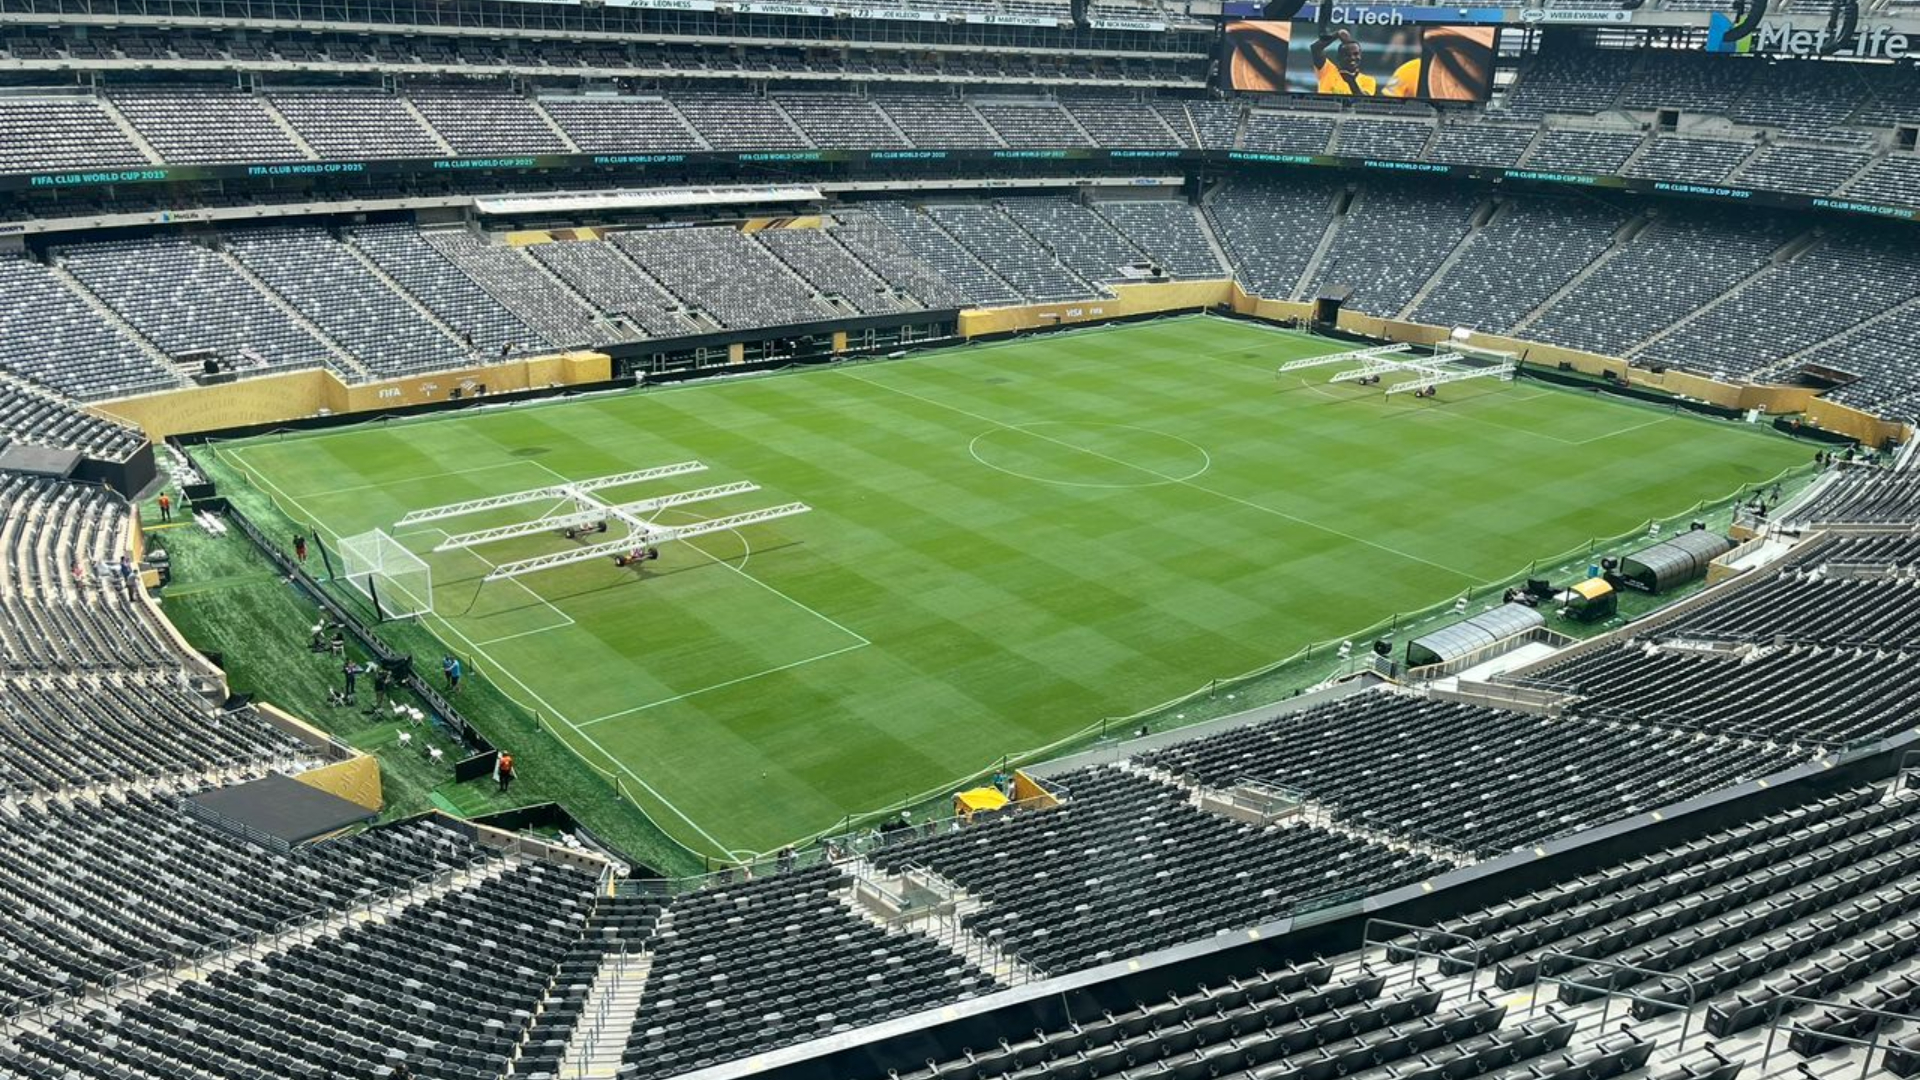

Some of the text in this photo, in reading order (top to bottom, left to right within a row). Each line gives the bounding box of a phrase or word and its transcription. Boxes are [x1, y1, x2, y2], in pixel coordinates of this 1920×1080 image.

[761, 5, 793, 13] WINSTON
[471, 159, 498, 167] WORLD
[595, 156, 609, 164] FIFA
[628, 155, 651, 163] WORLD
[249, 167, 267, 175] FIFA
[269, 165, 291, 174] CLUB
[292, 164, 323, 173] WORLD
[324, 163, 341, 172] CUP
[1395, 162, 1418, 170] WORLD
[31, 176, 54, 185] FIFA
[55, 174, 80, 184] CLUB
[82, 172, 119, 182] WORLD
[120, 171, 140, 180] CUP
[1505, 170, 1519, 178] FIFA
[1520, 171, 1536, 179] CLUB
[1563, 174, 1576, 182] CUP
[1671, 184, 1688, 192] CLUB
[1690, 186, 1715, 194] WORLD
[1829, 200, 1849, 209] CLUB
[1850, 203, 1877, 213] WORLD
[1878, 206, 1893, 214] CUP
[1066, 308, 1083, 317] VISA
[379, 387, 401, 399] FIFA
